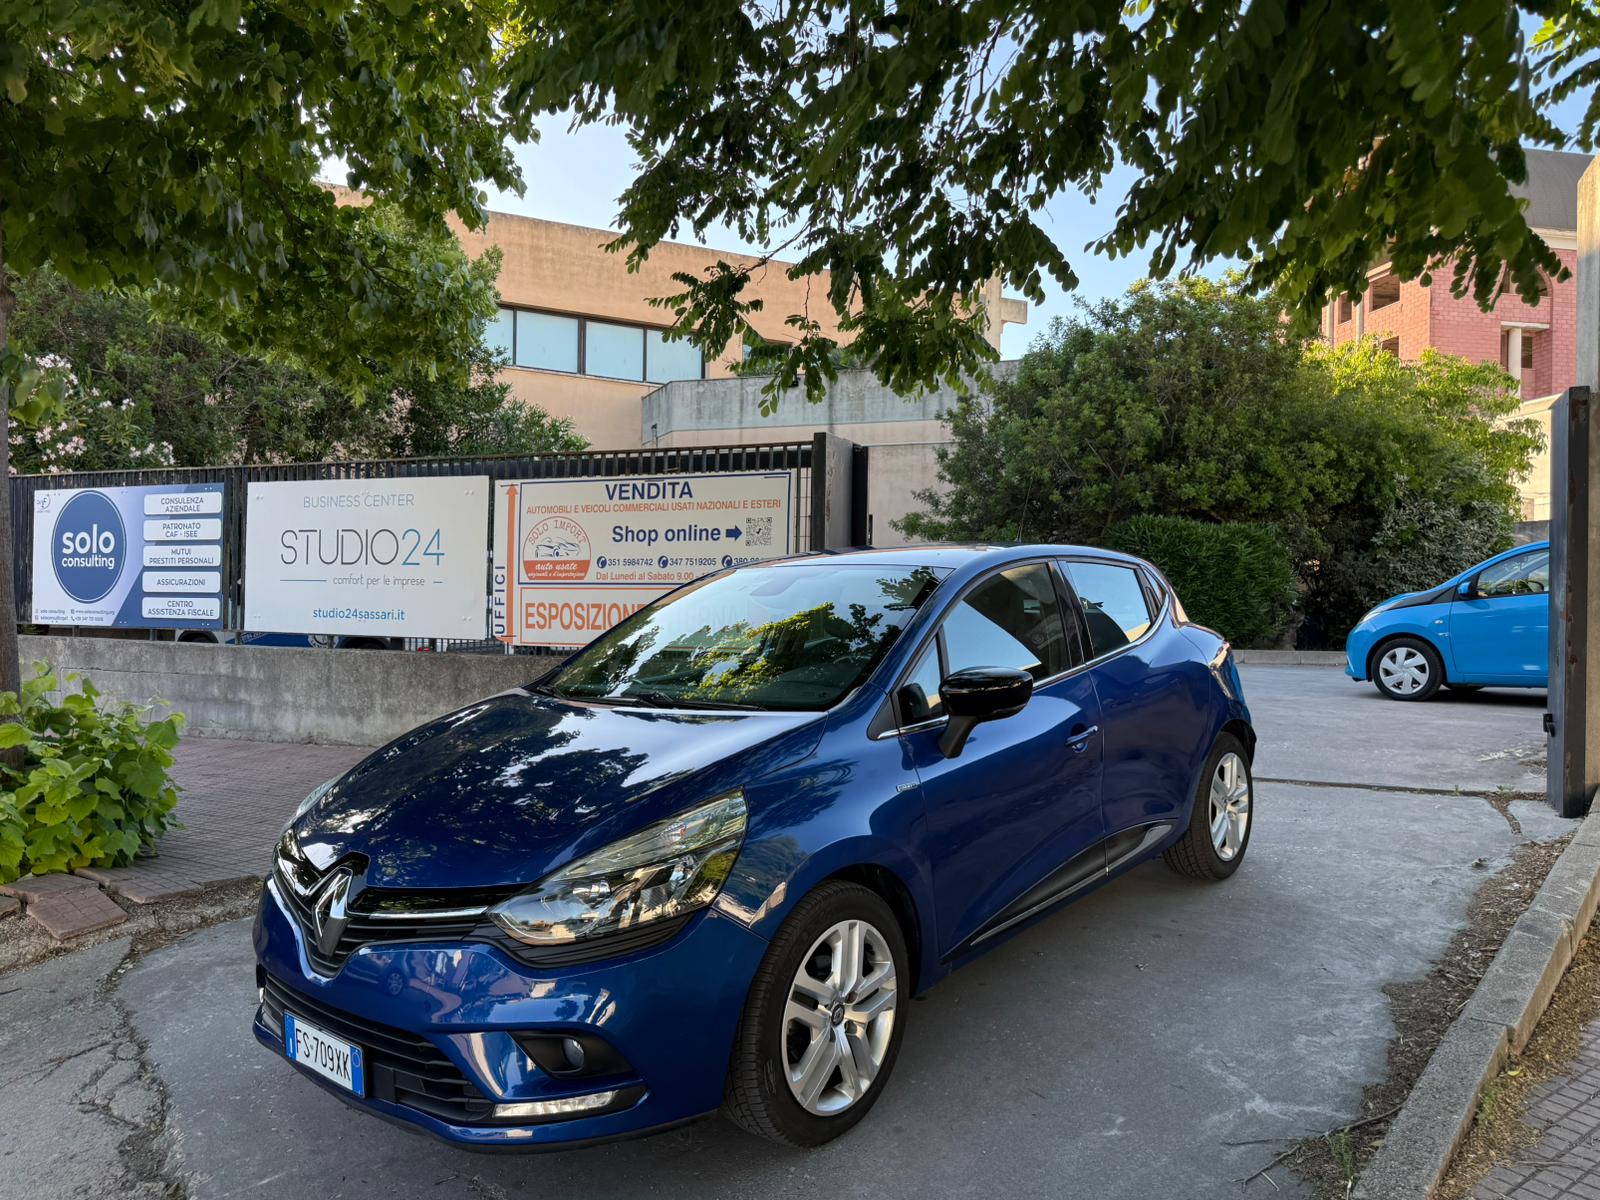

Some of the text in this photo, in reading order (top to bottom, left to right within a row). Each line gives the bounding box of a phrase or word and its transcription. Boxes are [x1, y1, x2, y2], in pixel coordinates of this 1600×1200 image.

[605, 481, 693, 500] VENDITA
[160, 496, 204, 505] CONSULENZA
[303, 494, 415, 508] BUSINESS CENTER
[526, 498, 781, 514] AUTOMOBILI E VEICOLI COMMERCIALI USATI NAZIONALI E ESTERI
[165, 505, 201, 513] AZIENDALE
[162, 522, 201, 530] PATRONATO
[528, 519, 587, 545] SOLO IMPORT
[62, 523, 115, 554] solo
[612, 524, 721, 546] Shop online
[280, 528, 445, 566] STUDIO24
[61, 554, 115, 570] consulting
[149, 557, 214, 565] PRESTITI PERSONALI
[535, 561, 579, 571] auto usate
[607, 558, 621, 566] 351
[669, 557, 717, 566] 347 7519205
[156, 578, 206, 586] ASSICURAZIONI
[332, 573, 425, 589] comfort per le imprese
[595, 571, 609, 580] Dal
[638, 571, 646, 580] al
[647, 571, 675, 580] Sabato
[676, 571, 695, 580] 9.00
[166, 600, 194, 608] CENTRO
[494, 565, 506, 635] UFFICI
[147, 608, 215, 617] ASSISTENZA FISCALE
[312, 607, 405, 621] studio24sassari.it
[525, 602, 646, 631] ESPOSIZION
